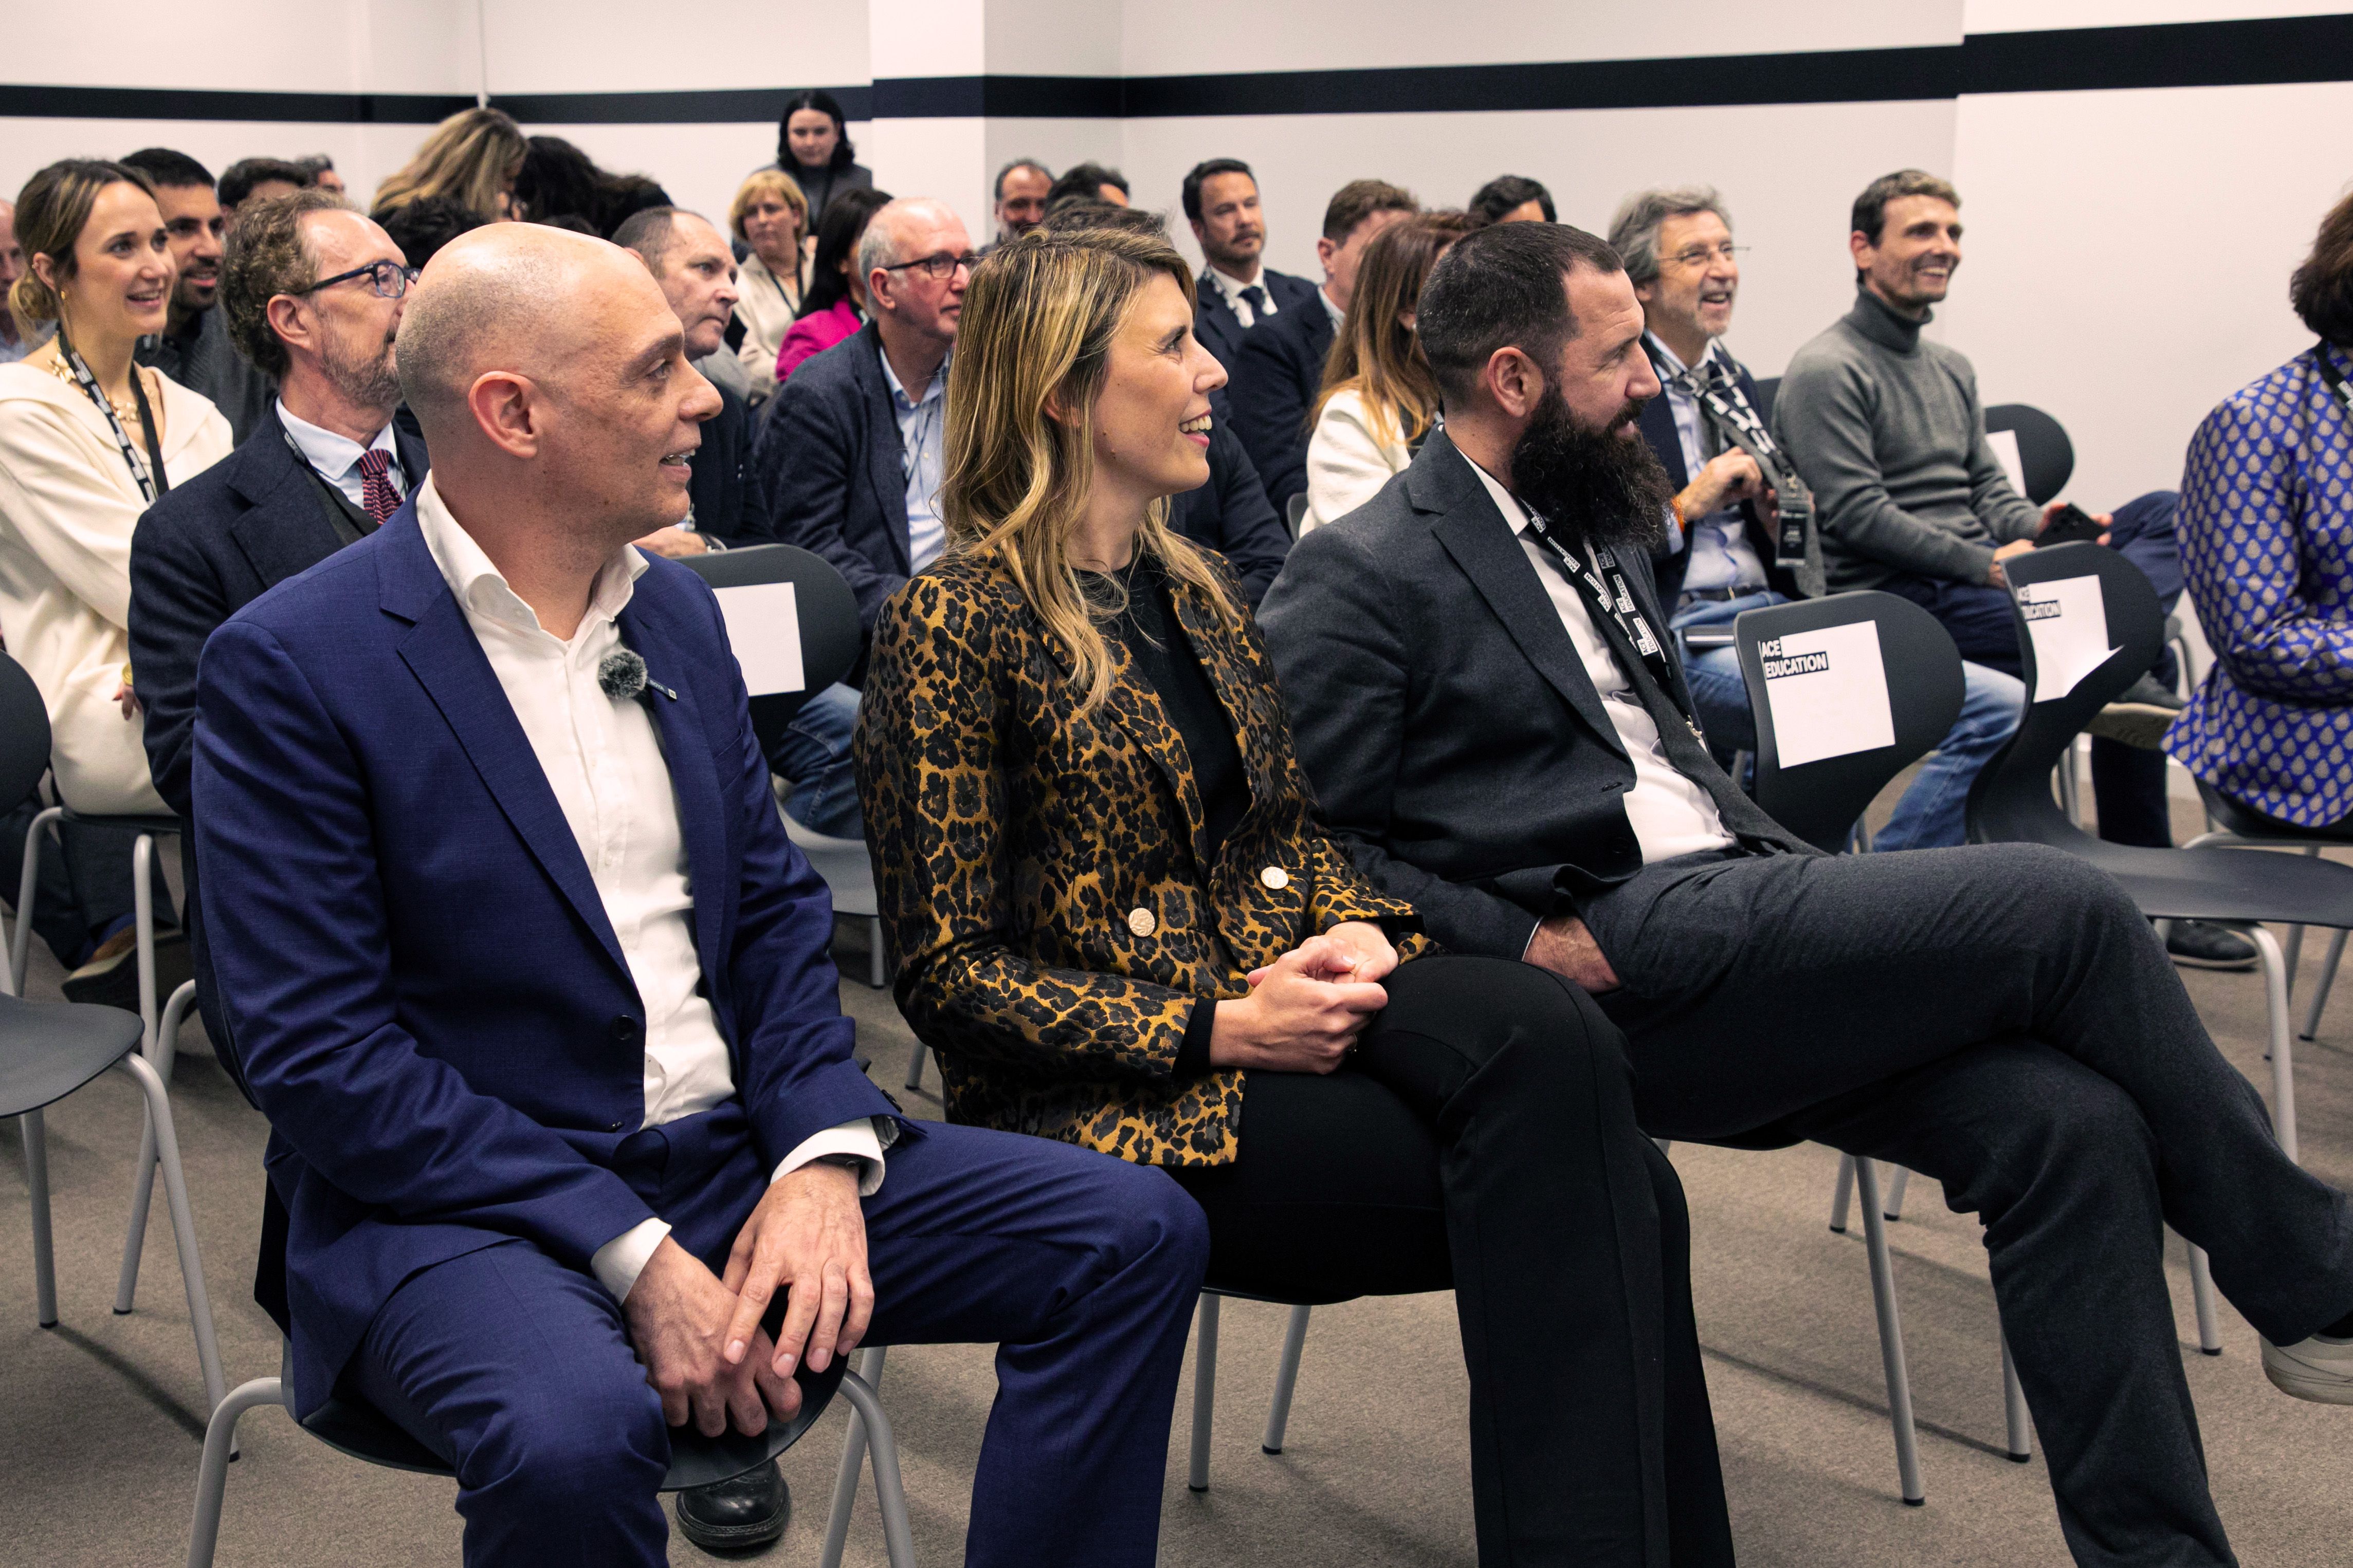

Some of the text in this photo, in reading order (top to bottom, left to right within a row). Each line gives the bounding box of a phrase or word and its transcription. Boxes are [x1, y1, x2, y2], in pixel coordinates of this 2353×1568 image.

[1598, 554, 1608, 567] ACE
[1586, 575, 1611, 606] EDUCATION
[1615, 576, 1634, 610] EDUCATION
[1600, 597, 1609, 610] ACE
[1618, 599, 1627, 611] ACE
[1635, 619, 1656, 651] EDUCATION
[1640, 640, 1649, 653] ACE
[1761, 639, 1781, 658] ACE
[1764, 653, 1828, 678] EDUCATION
